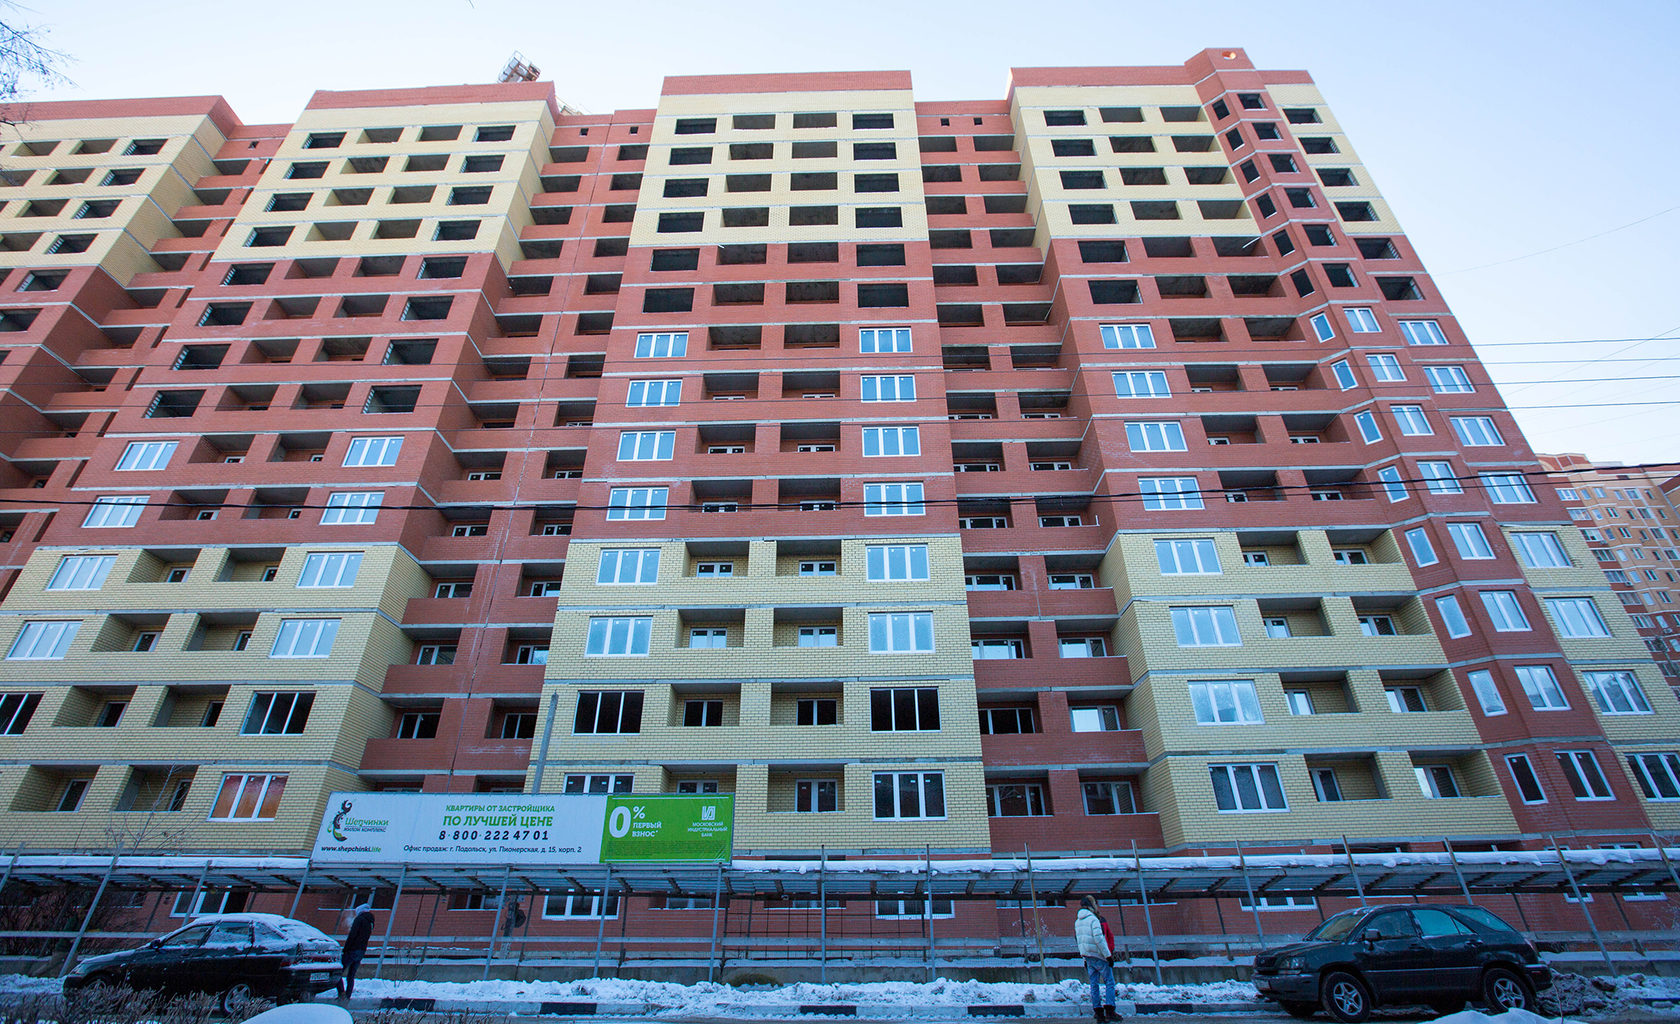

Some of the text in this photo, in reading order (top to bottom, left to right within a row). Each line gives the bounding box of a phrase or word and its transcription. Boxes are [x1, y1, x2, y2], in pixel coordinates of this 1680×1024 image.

[499, 804, 555, 813] ЗАСТРОЙЩИКА
[443, 813, 553, 828] ПО ЛУЧШЕЙ ЦЕНЕ
[633, 821, 662, 829] ПЕРВЫЙ
[321, 845, 381, 853] www.shepchinki.life
